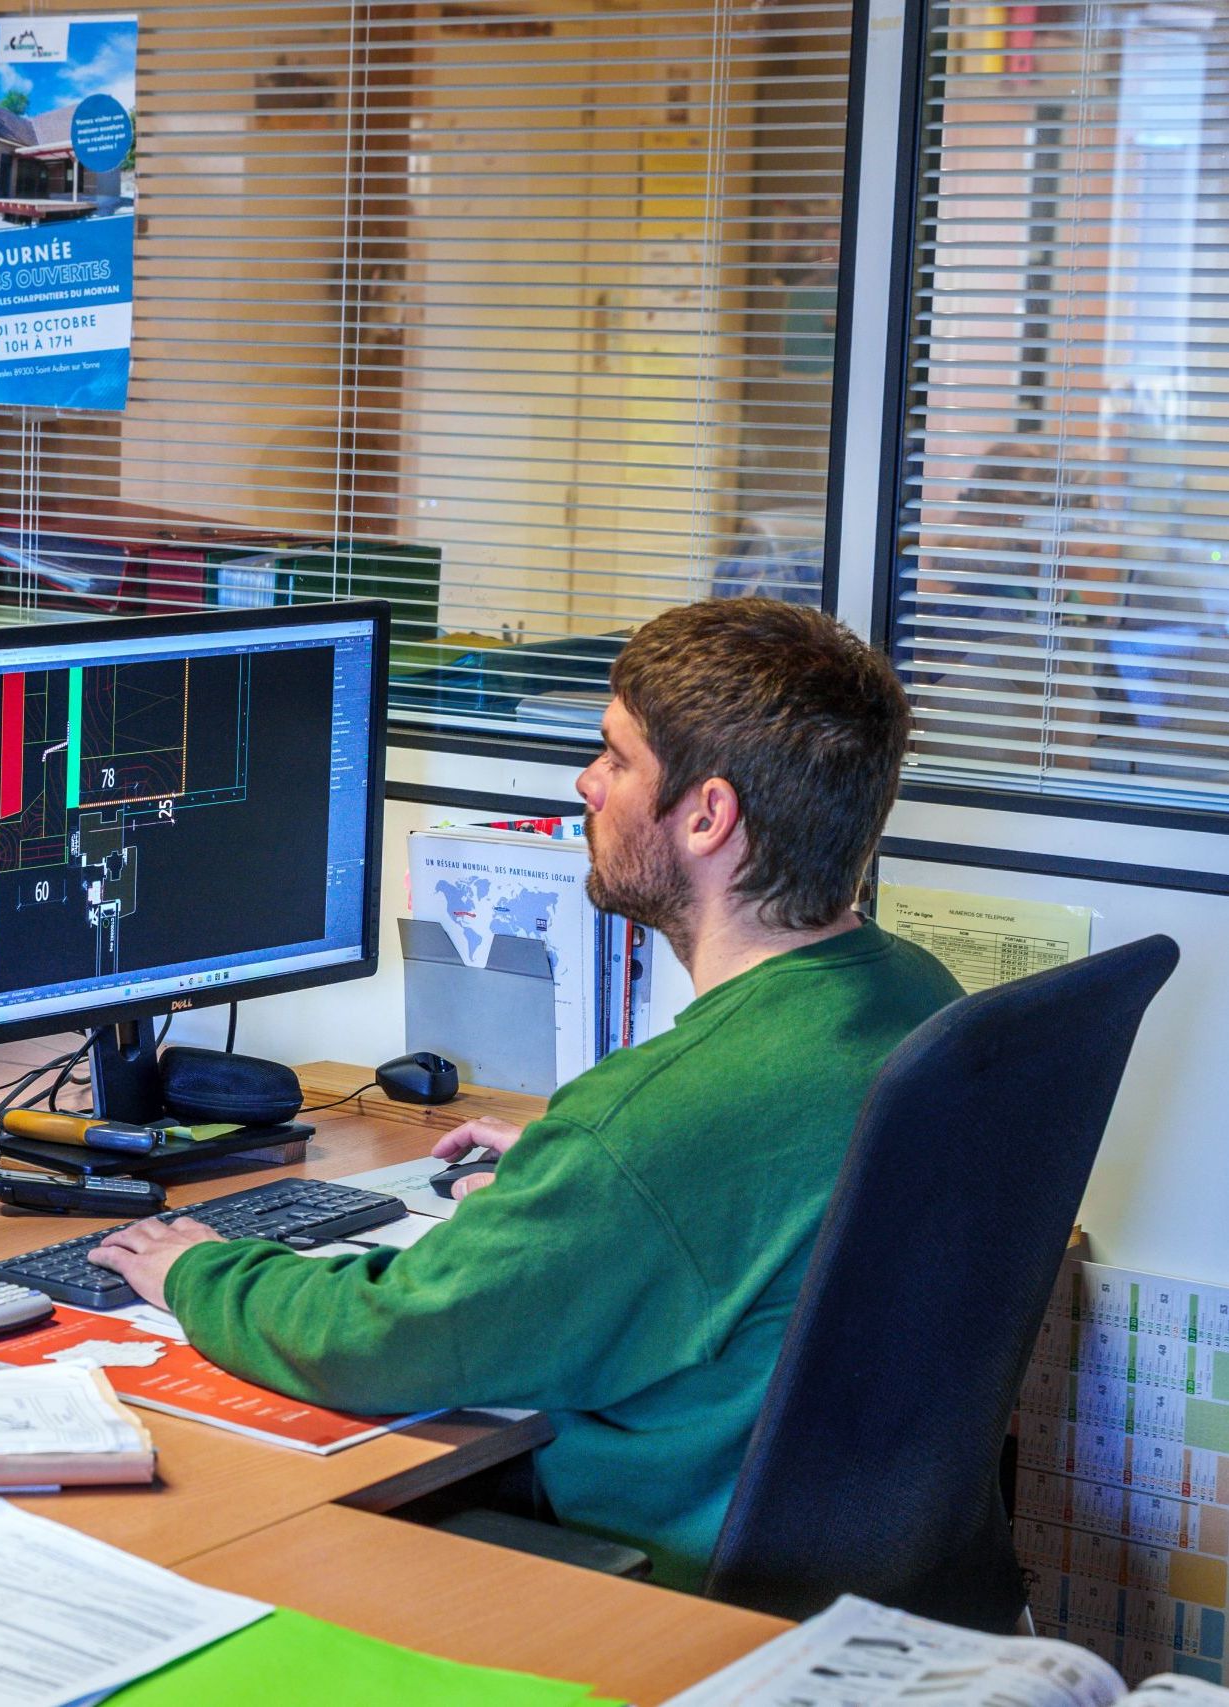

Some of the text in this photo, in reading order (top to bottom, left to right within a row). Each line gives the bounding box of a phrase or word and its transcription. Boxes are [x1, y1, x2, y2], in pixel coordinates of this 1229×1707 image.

[16, 259, 112, 288] OUVERTES
[0, 297, 12, 306] LES
[13, 292, 69, 304] CHARPENTIERS
[70, 290, 82, 298] DU
[84, 285, 120, 296] MORVAN
[15, 322, 27, 334] 12
[34, 315, 96, 332] OCTOBRE
[6, 340, 28, 352] 10H
[35, 336, 42, 349] À
[50, 336, 72, 348] 17H
[102, 768, 114, 788] 78
[158, 800, 172, 818] 25
[437, 858, 460, 868] RÉSEAU
[495, 866, 506, 874] DES
[509, 868, 548, 880] PARTENAIRES
[551, 874, 575, 883] LOCAUX
[36, 881, 49, 901] 60
[171, 999, 192, 1010] DELL
[1102, 1284, 1110, 1292] 51
